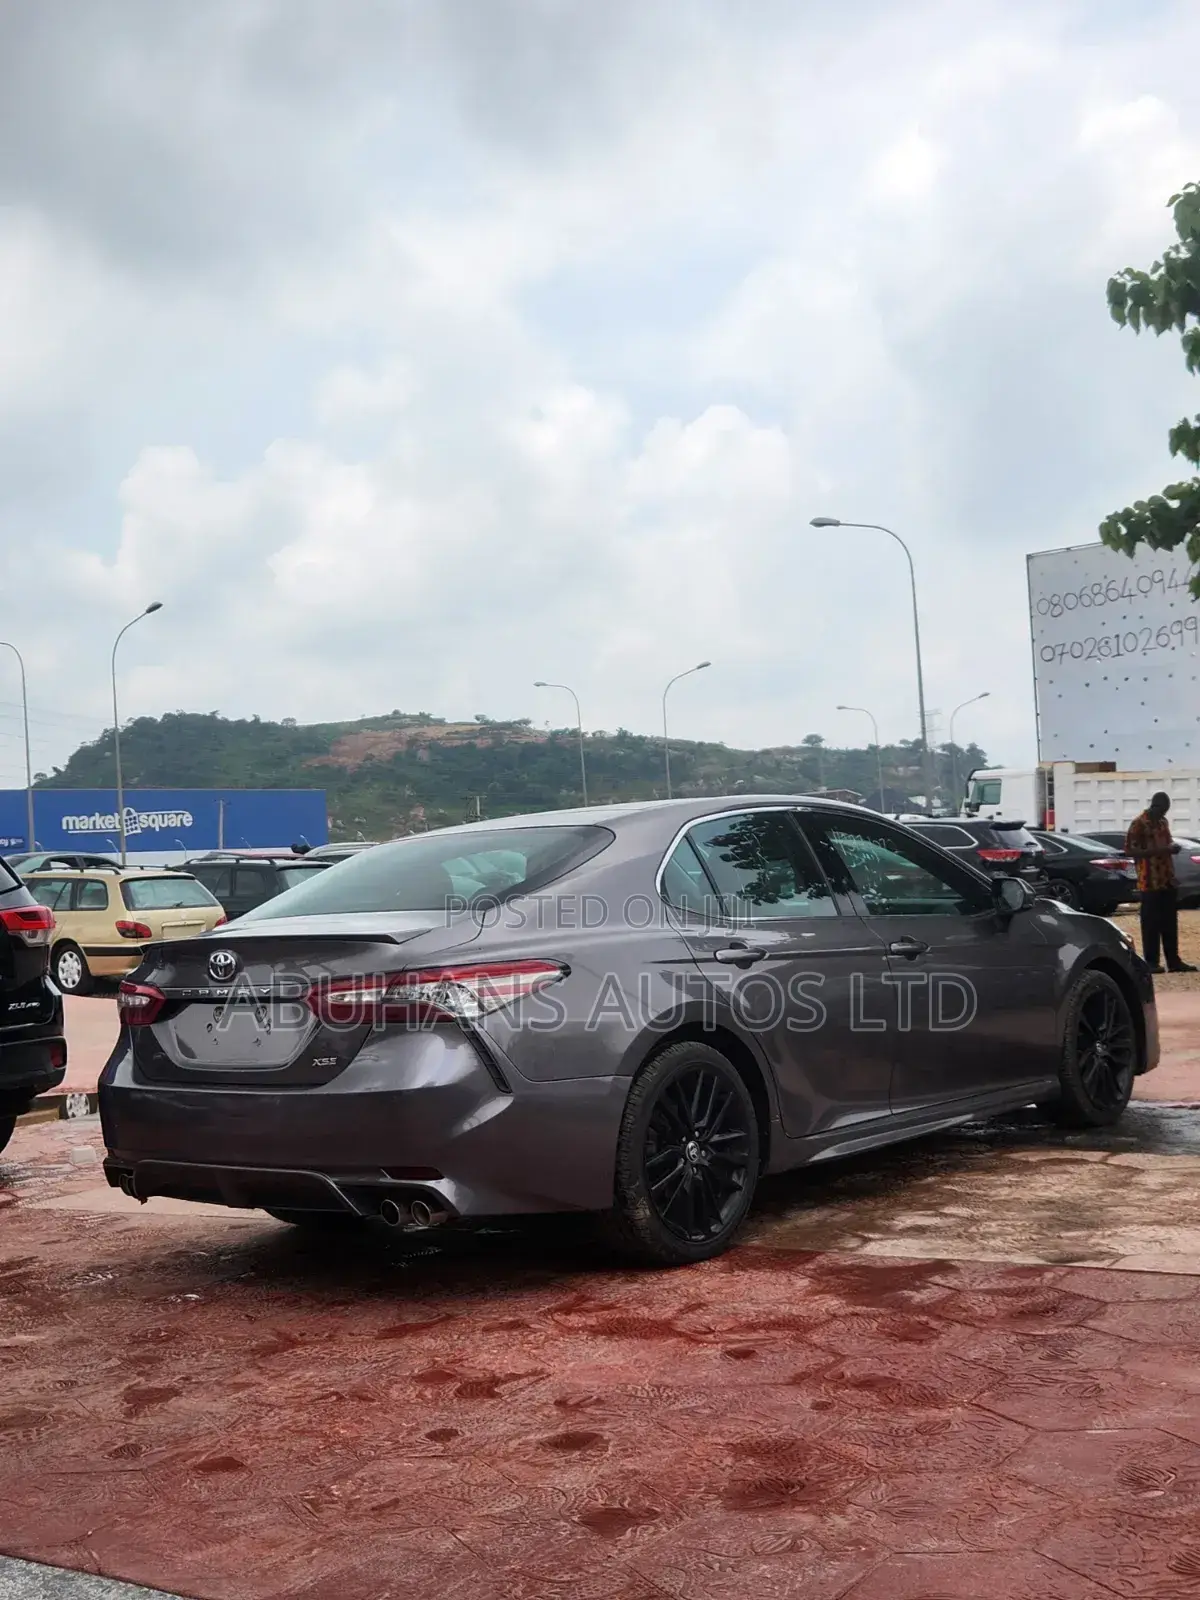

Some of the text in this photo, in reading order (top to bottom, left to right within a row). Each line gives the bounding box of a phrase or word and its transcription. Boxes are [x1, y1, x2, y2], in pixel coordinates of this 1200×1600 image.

[1040, 616, 1198, 665] 07026102699
[61, 812, 193, 832] market square
